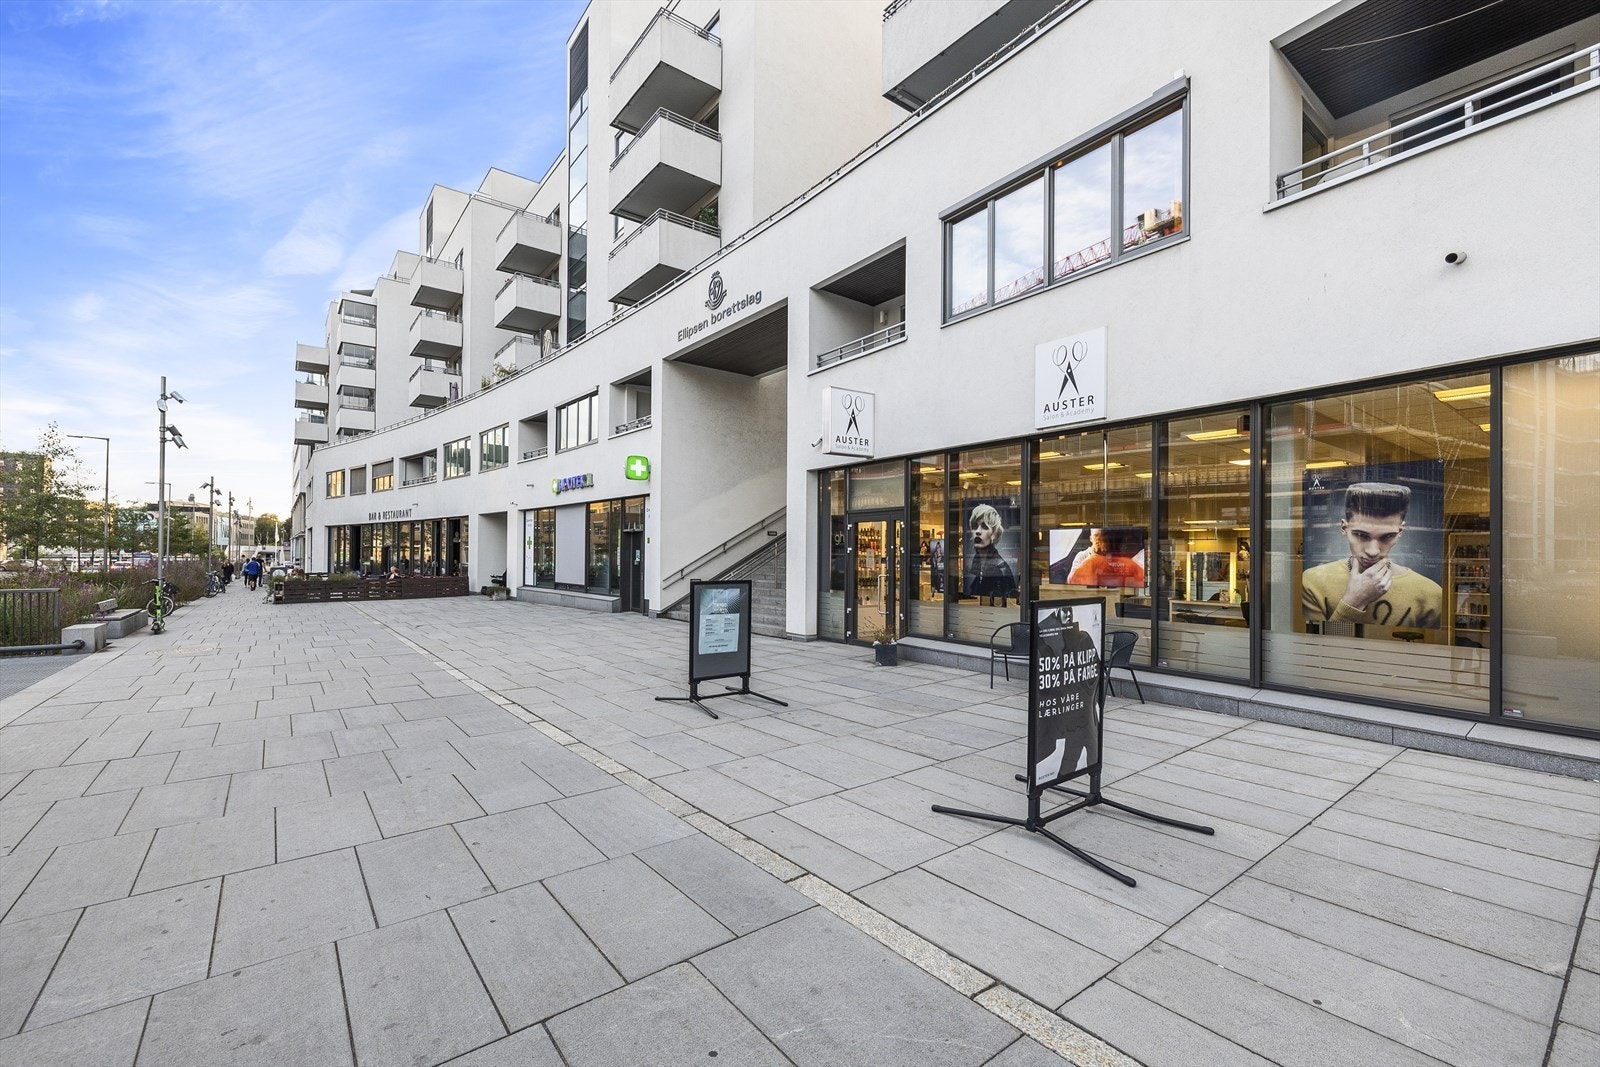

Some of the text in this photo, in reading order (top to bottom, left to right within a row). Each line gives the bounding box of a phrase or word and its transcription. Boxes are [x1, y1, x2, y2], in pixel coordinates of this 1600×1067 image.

[677, 290, 762, 342] Ellipsen borettslag
[1043, 395, 1095, 414] AUSTER
[1043, 407, 1095, 421] Salon & Academy
[835, 435, 870, 447] AUSTER
[368, 512, 377, 521] BAR
[382, 508, 412, 520] RESTAURANT
[1038, 648, 1096, 672] 50% PÅ KLIPP
[1038, 663, 1098, 690] 30% PÅ FARGE
[1039, 692, 1080, 708] HOS VÅRE
[1038, 701, 1084, 718] LÆRLINGER
